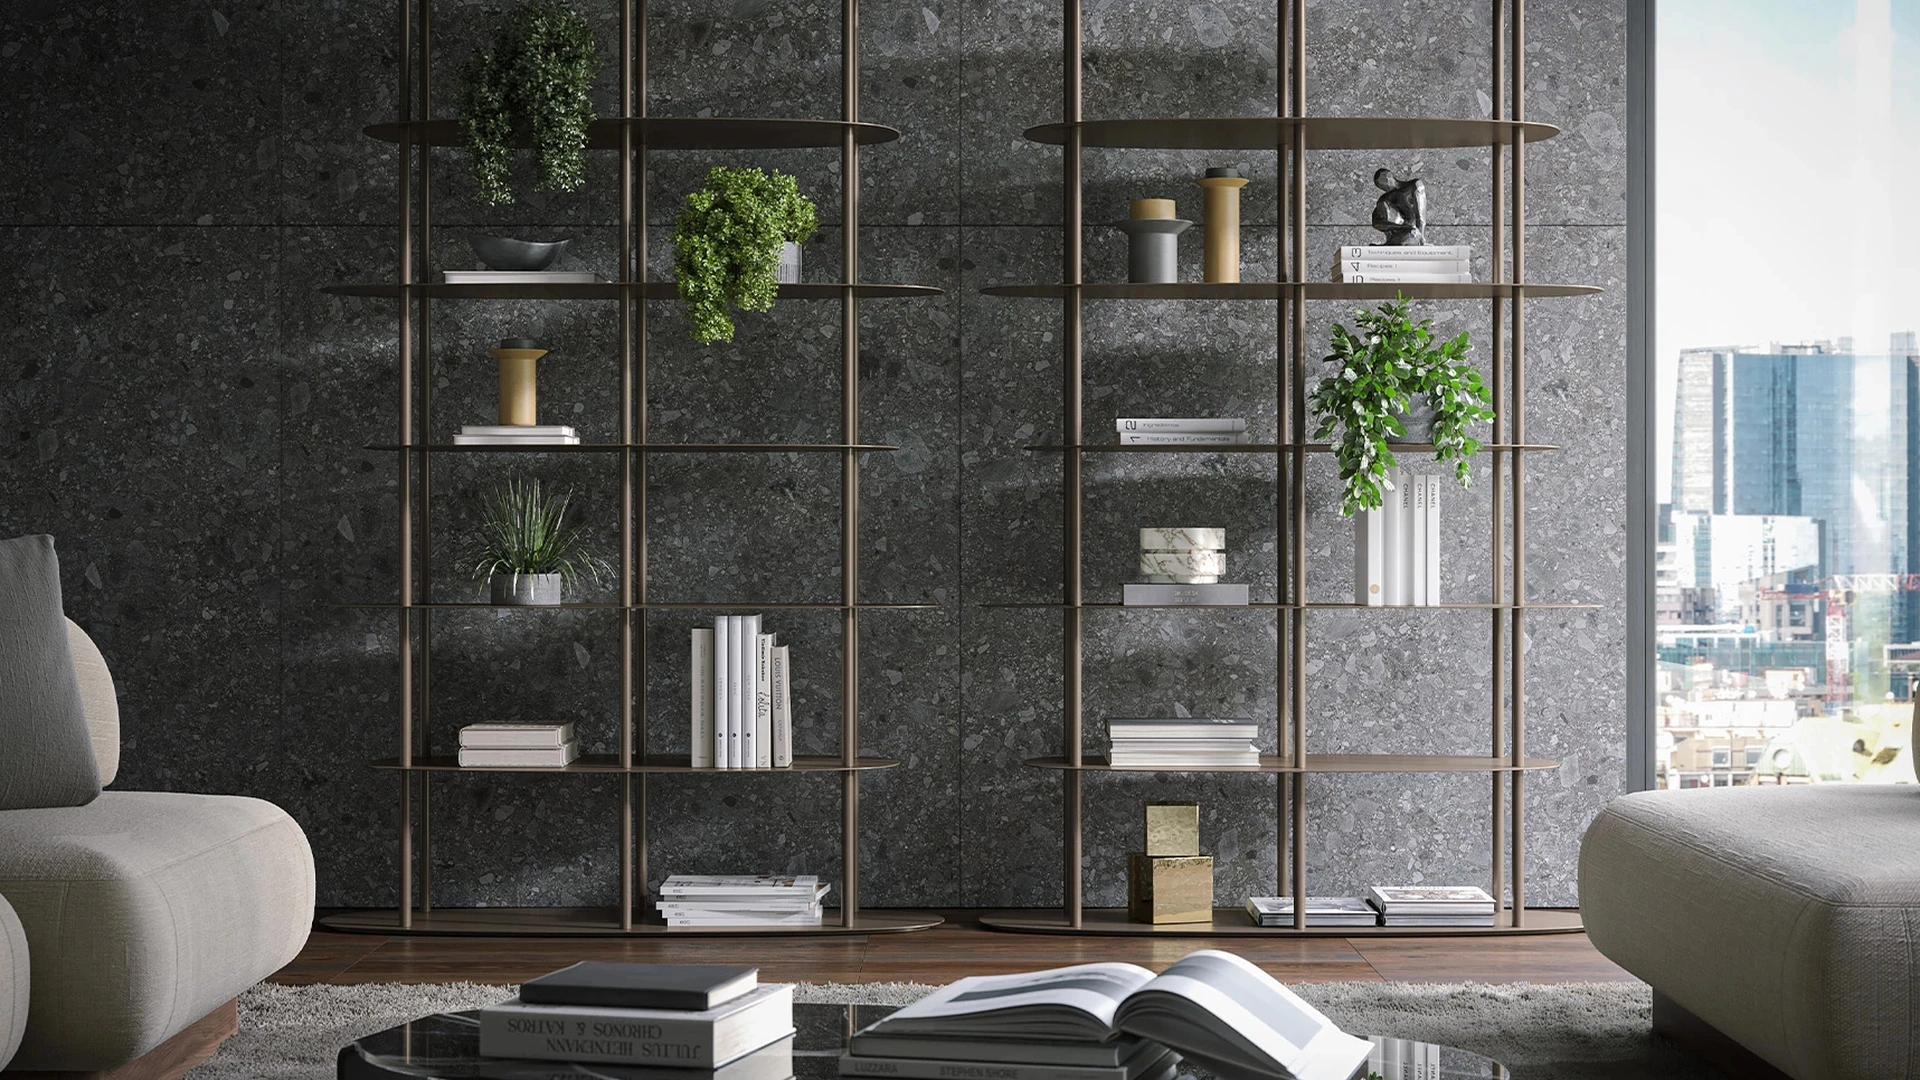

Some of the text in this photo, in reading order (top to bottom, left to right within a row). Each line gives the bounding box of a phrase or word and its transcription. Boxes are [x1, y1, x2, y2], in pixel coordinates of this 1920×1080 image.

[1351, 247, 1362, 258] 3
[1350, 262, 1360, 272] 4
[1125, 420, 1137, 430] 2
[1146, 435, 1171, 443] History
[774, 657, 782, 710] LOUIS VUITTON
[507, 1018, 663, 1039] CHRONOS & KAIROS
[546, 1037, 702, 1060] JULIUS HEINEMANN
[854, 1062, 898, 1075] LUZZARA
[940, 1065, 1018, 1079] STEPHEN SHORE
